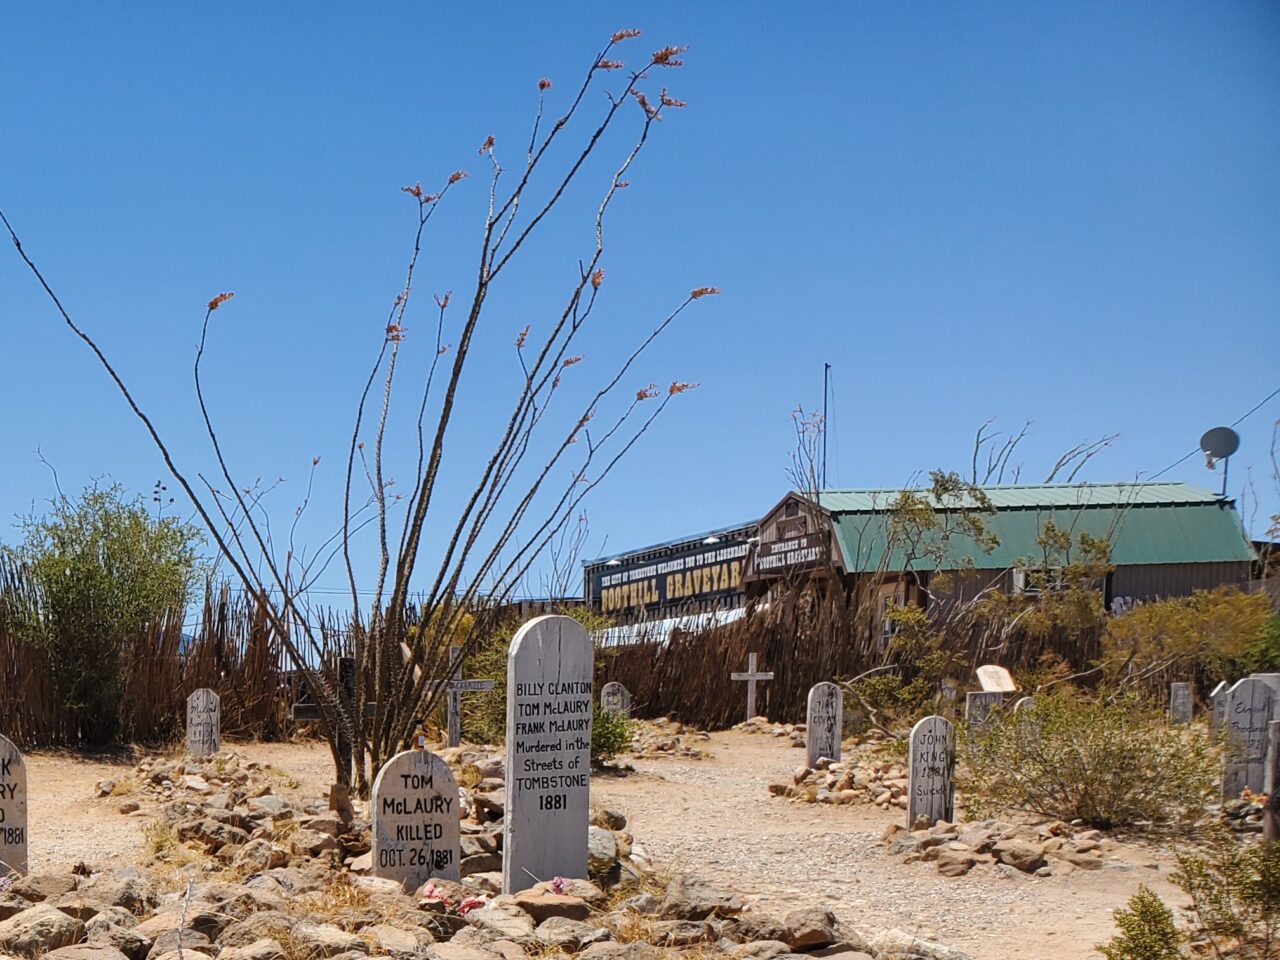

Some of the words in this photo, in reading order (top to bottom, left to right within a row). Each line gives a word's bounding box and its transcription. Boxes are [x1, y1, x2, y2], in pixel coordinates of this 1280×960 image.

[771, 540, 799, 554] ENTRANCE
[602, 576, 610, 586] THE
[611, 574, 621, 585] CITY
[623, 572, 628, 582] OF
[630, 565, 657, 580] TOMBSTONE
[658, 559, 684, 574] WELCOMES
[685, 556, 696, 568] YOU
[696, 554, 703, 566] TO
[704, 552, 716, 564] THE
[716, 544, 749, 561] LEGENDARY
[601, 578, 659, 612] BOOTHILL
[666, 560, 742, 600] GRAVEYAR
[516, 682, 545, 696] BILLY
[548, 682, 592, 695] CLANTON
[518, 702, 540, 717] TOM
[544, 700, 590, 715] McLAURY
[516, 722, 545, 736] FRANK
[549, 719, 590, 733] McLAURY
[516, 738, 562, 754] Murdered
[565, 740, 574, 750] in
[576, 737, 589, 750] the
[920, 734, 947, 745] JOHN
[524, 758, 563, 772] Streets
[568, 756, 580, 770] of
[920, 752, 945, 763] KING
[401, 774, 433, 789] TOM
[516, 774, 587, 792] TOMBSTONE
[383, 797, 453, 815] McLAURY
[539, 795, 567, 810] 1881
[4, 828, 24, 844] 1881
[396, 824, 442, 841] KILLED
[380, 849, 406, 868] OCT.
